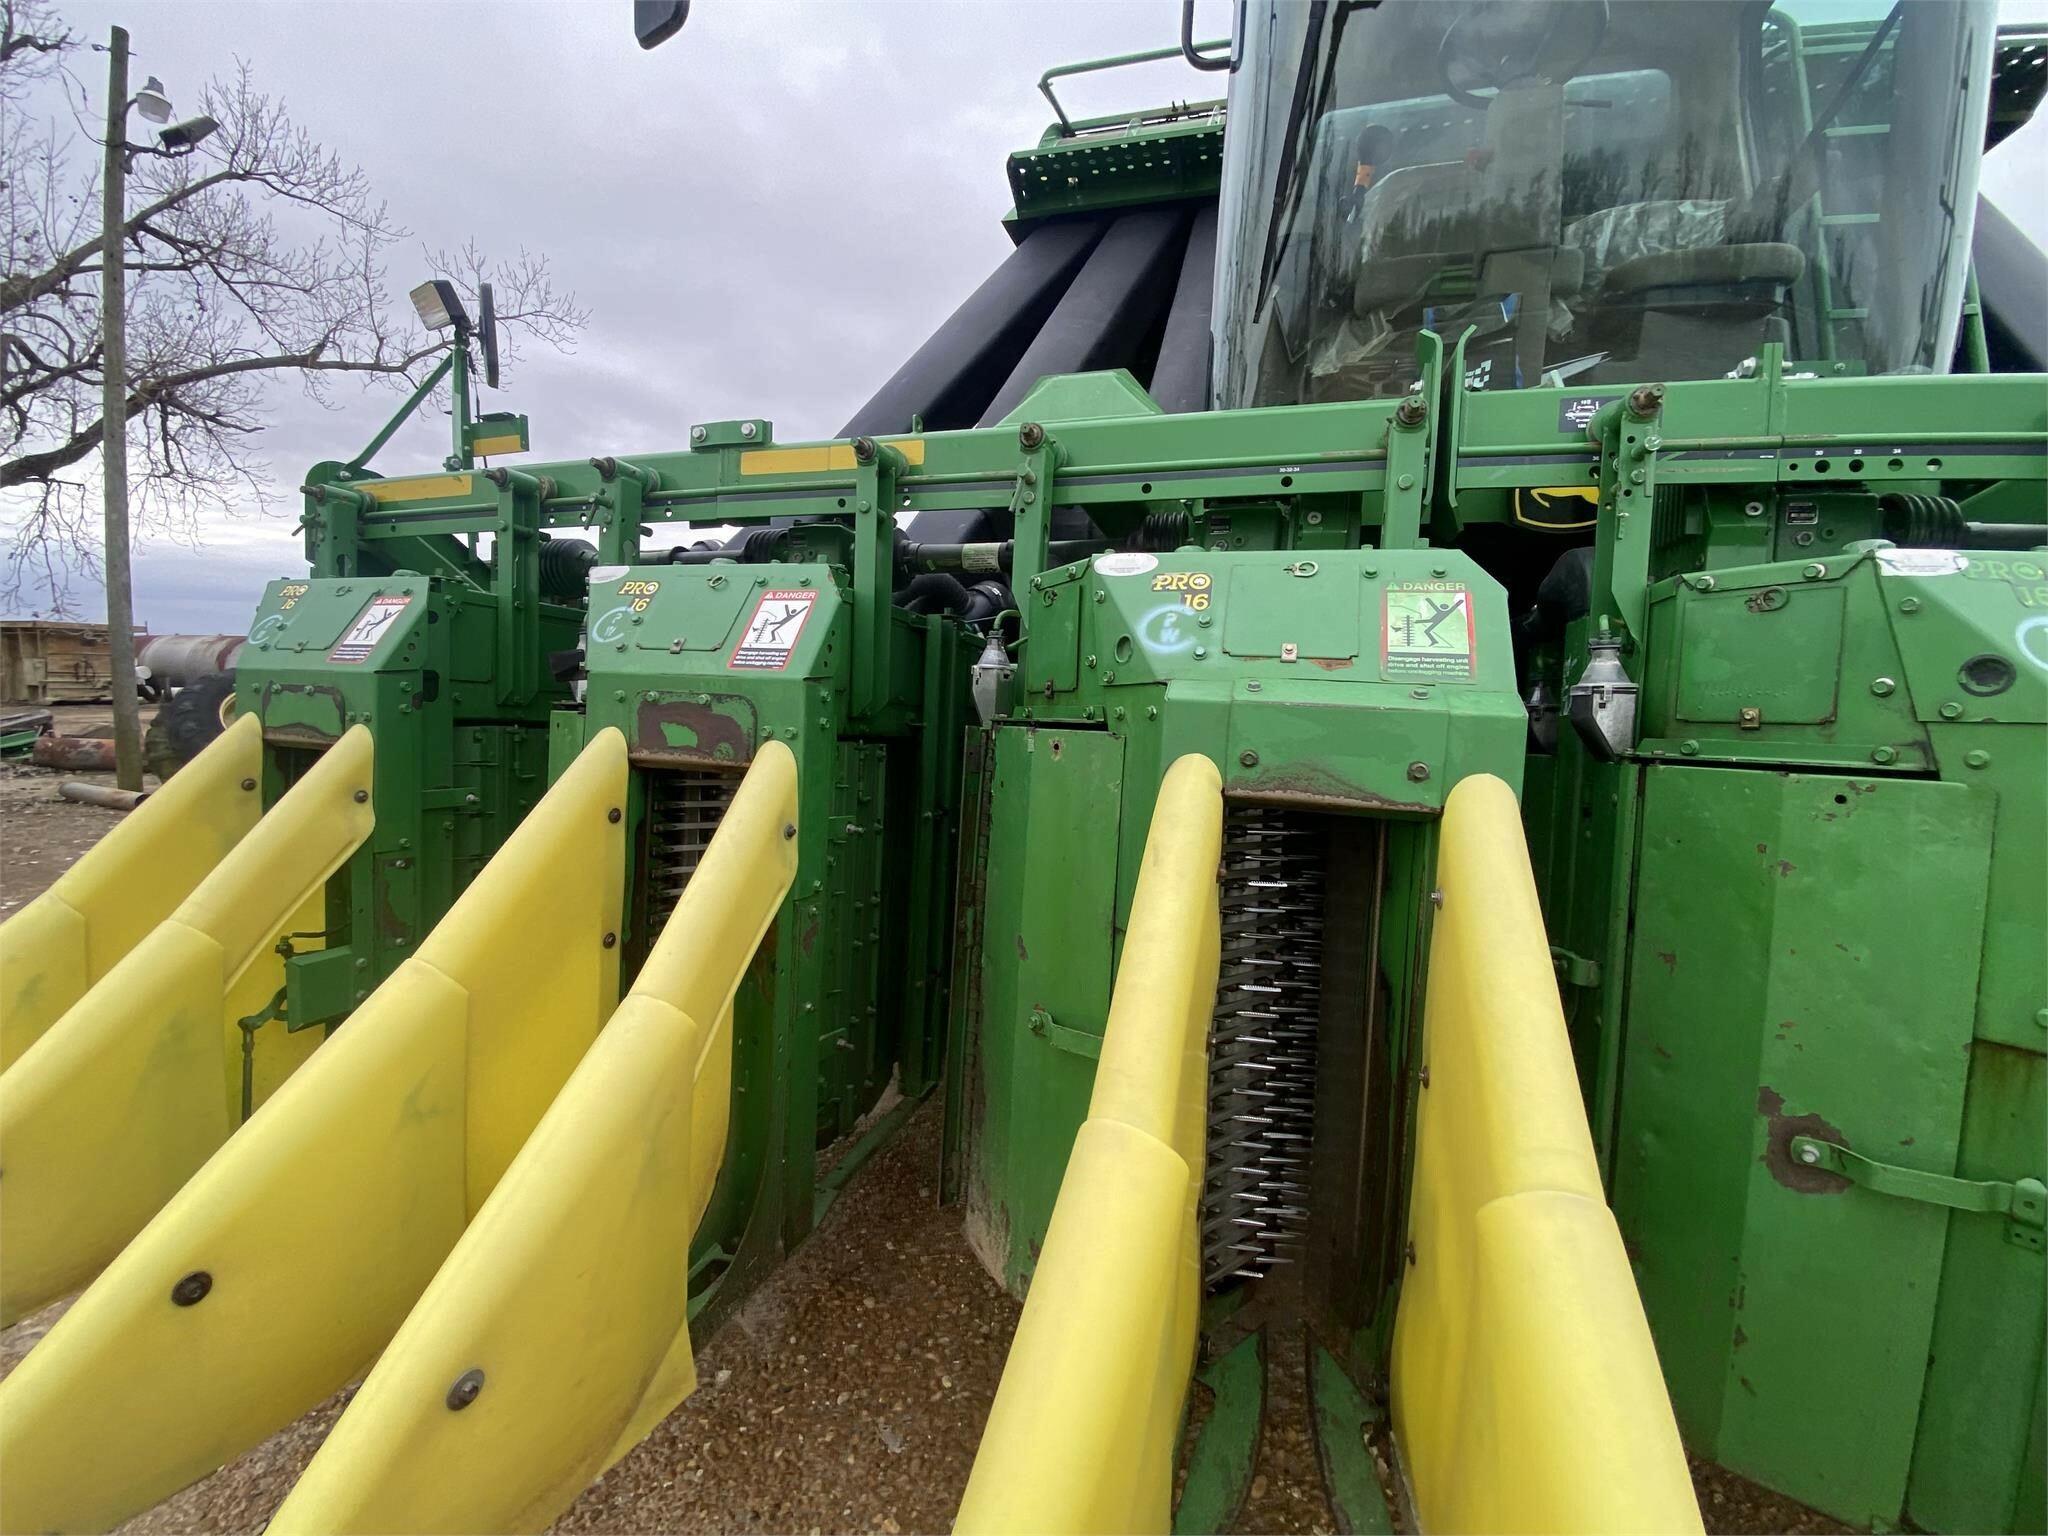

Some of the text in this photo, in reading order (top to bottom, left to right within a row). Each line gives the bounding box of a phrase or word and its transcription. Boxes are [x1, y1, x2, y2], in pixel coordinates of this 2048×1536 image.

[1967, 560, 2044, 580] PRO
[618, 582, 659, 595] PRO
[1153, 574, 1211, 591] PRO
[1403, 582, 1466, 591] DANGER
[279, 585, 309, 597] PRO
[280, 598, 298, 610] 16
[631, 598, 650, 611] 16
[1184, 593, 1209, 611] 16
